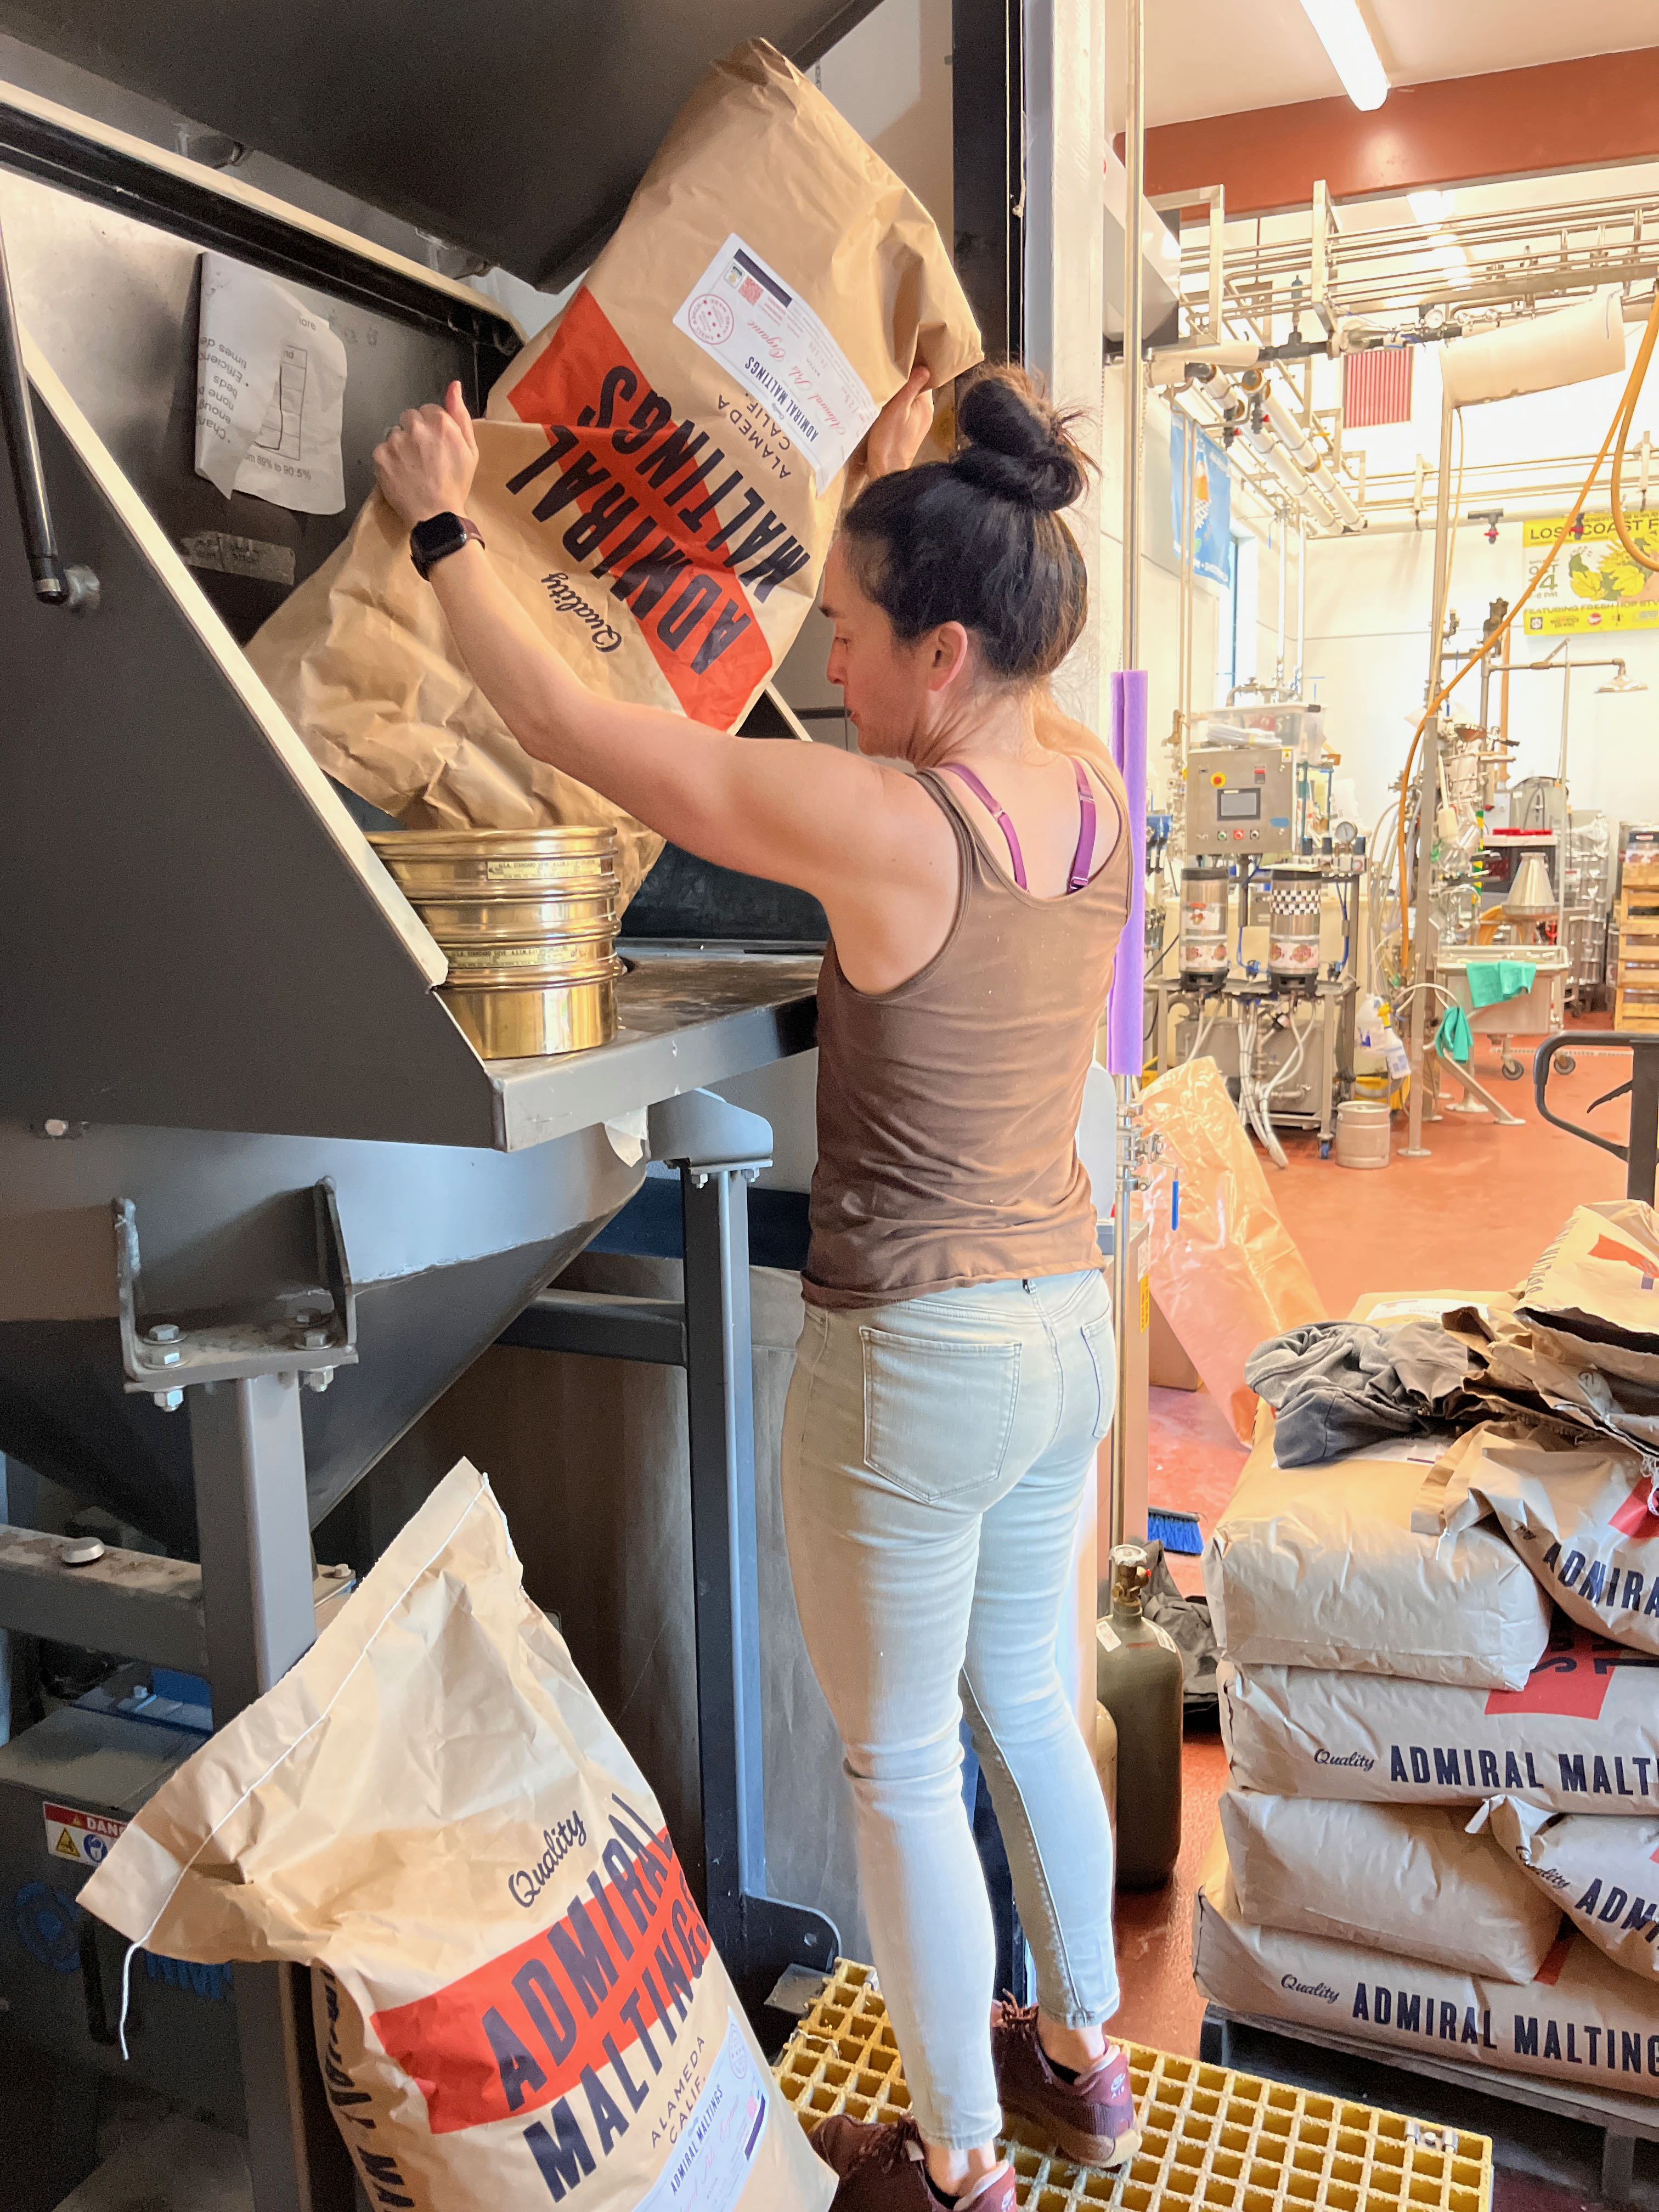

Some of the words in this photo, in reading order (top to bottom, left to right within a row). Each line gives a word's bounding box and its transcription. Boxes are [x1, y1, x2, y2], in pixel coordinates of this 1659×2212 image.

[218, 343, 247, 369] times
[747, 320, 786, 363] Organic
[208, 388, 234, 411] none
[213, 375, 238, 400] beds
[744, 356, 789, 405] MALTINGS
[718, 394, 792, 479] ALAMEDA
[744, 392, 791, 450] CALIF.
[786, 406, 819, 442] ADMIRAL
[274, 462, 281, 472] to
[577, 365, 811, 604] MALTINGS
[505, 425, 752, 675] ADMIRAL
[1531, 526, 1573, 540] LOS
[1528, 563, 1560, 575] OT
[541, 572, 622, 653] Quality
[1525, 605, 1578, 614] FEATURING
[1581, 603, 1614, 611] FRESH
[1314, 1748, 1374, 1771] Quality
[1390, 1745, 1544, 1788] ADMIRAL
[509, 1810, 586, 1908] Quality
[482, 1792, 674, 2112] ADMIRAL
[523, 1869, 708, 2203] MALTINGS
[1280, 1973, 1340, 2004] Quality
[1352, 1982, 1498, 2049] ADMIRAL
[652, 2036, 705, 2149] ALAMEDA
[670, 2076, 706, 2145] CALIF.
[670, 2143, 699, 2197] ADMIRAL
[696, 2084, 724, 2145] MALTINGS
